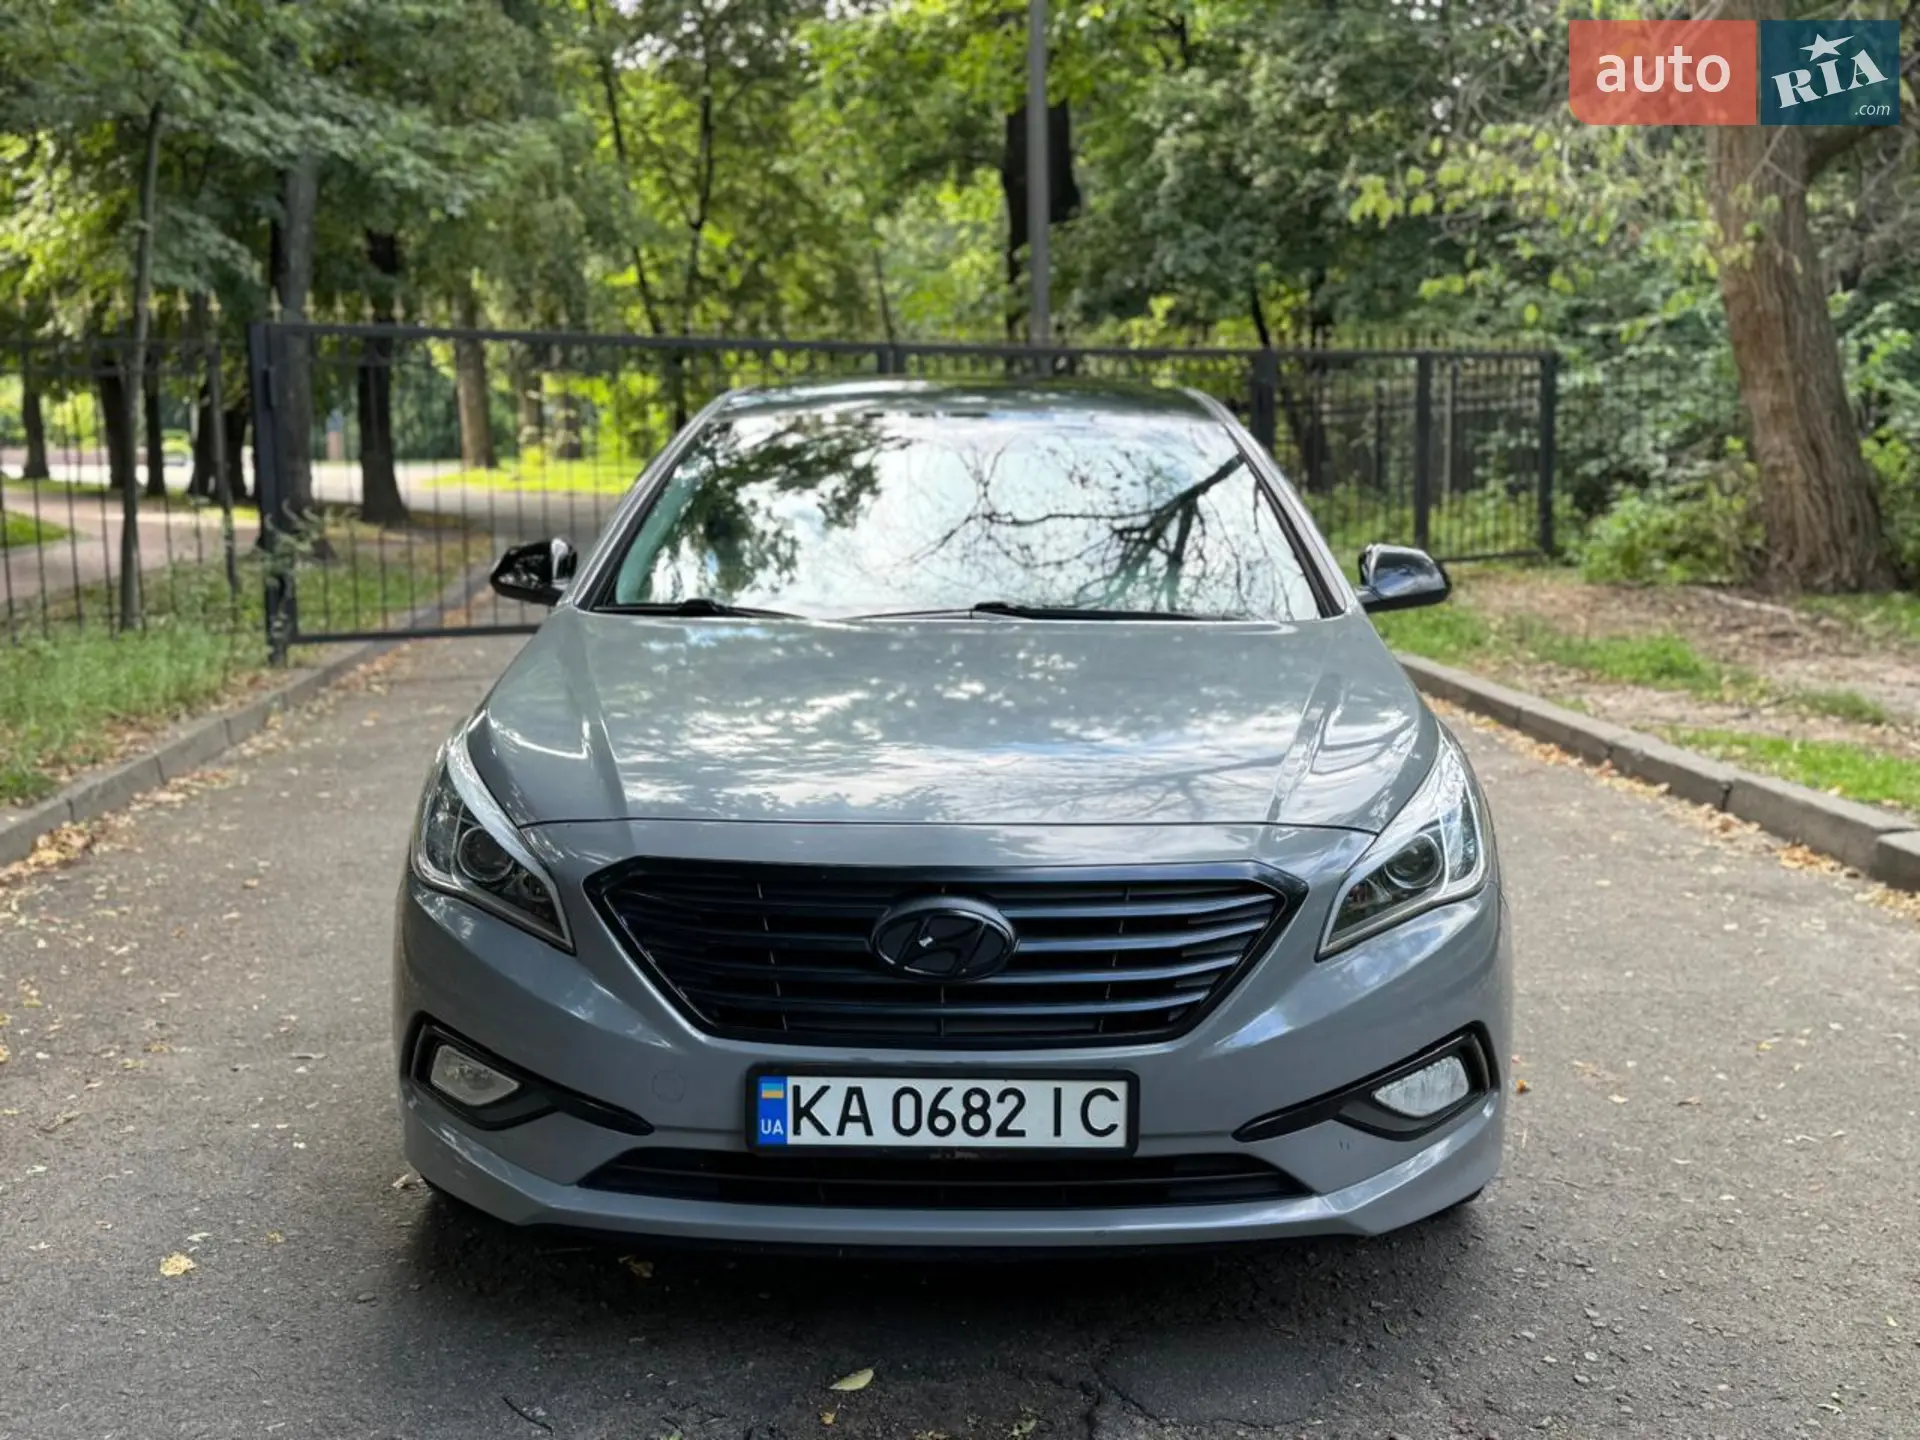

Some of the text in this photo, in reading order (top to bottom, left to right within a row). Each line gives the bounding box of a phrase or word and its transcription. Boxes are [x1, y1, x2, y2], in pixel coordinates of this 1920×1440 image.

[760, 1119, 784, 1135] UA
[792, 1085, 1120, 1138] KA 0682 IC
